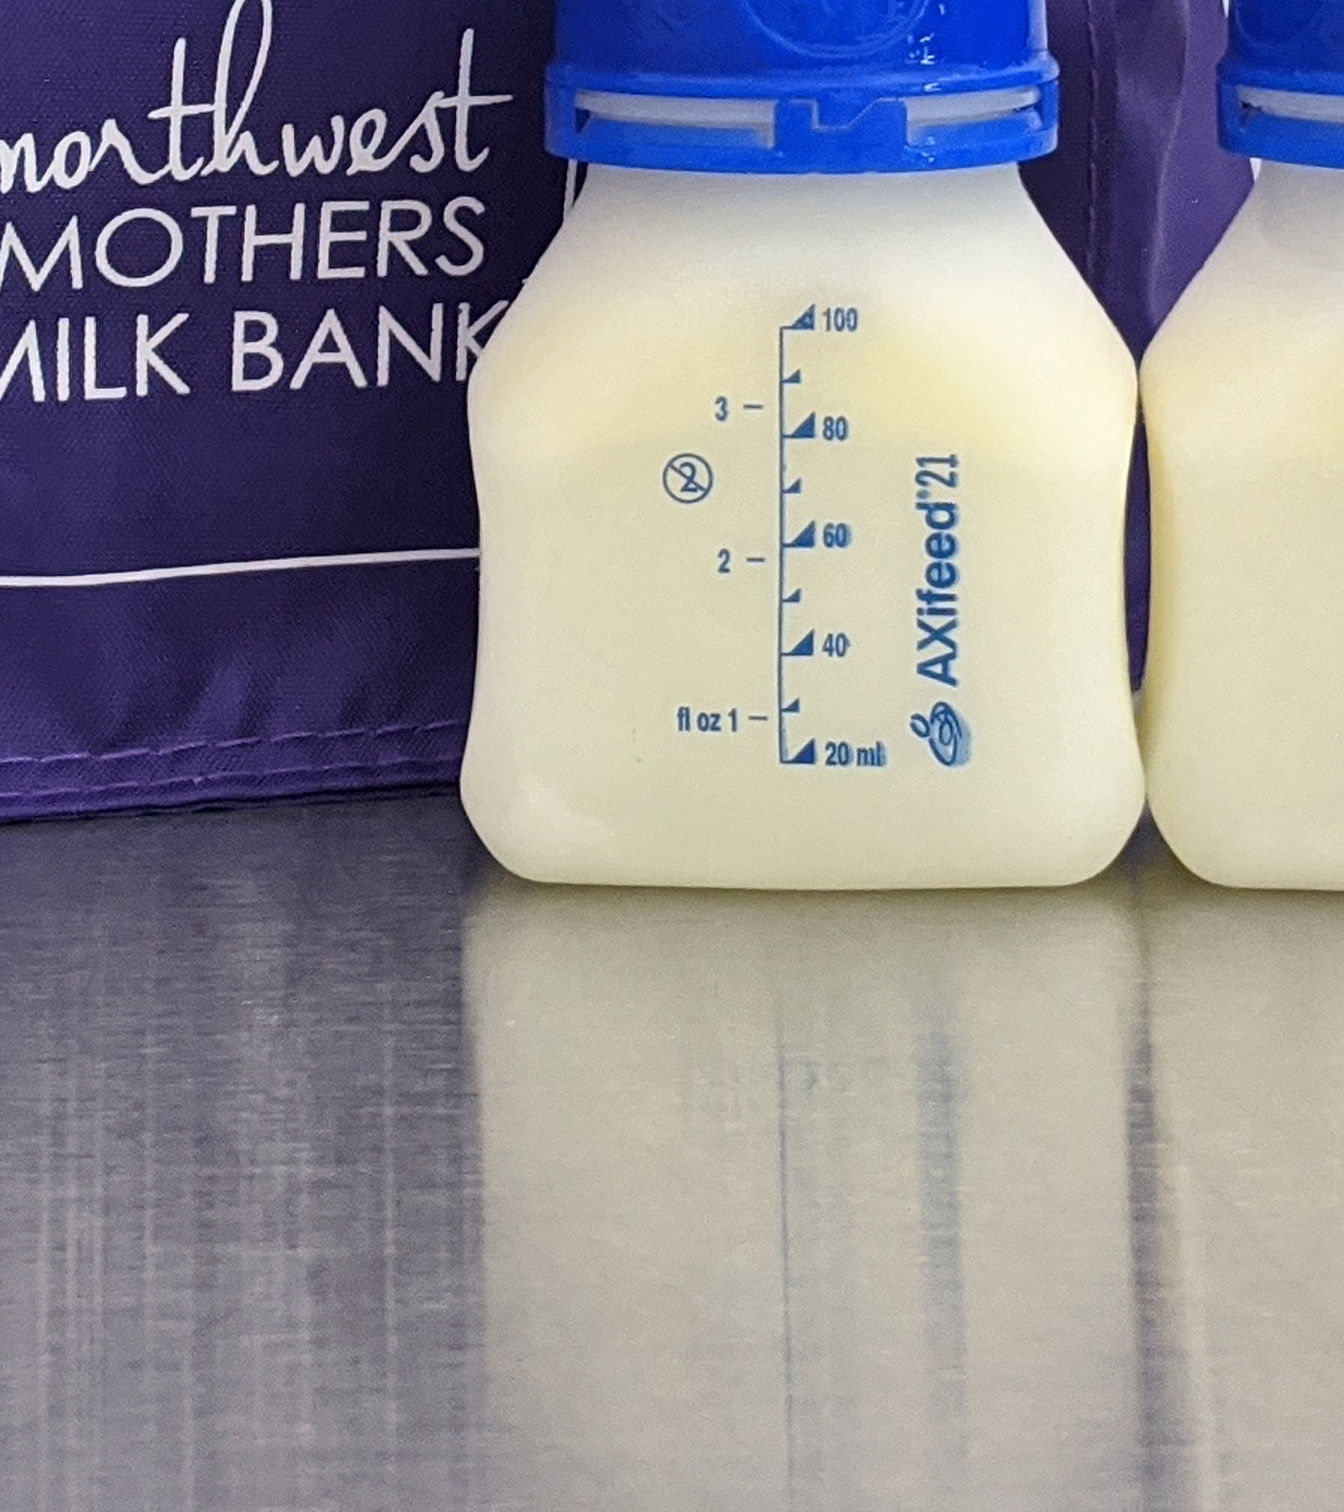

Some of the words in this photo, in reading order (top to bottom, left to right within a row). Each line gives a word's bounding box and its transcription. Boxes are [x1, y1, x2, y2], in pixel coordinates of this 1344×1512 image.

[821, 306, 859, 333] 100
[231, 300, 509, 392] BANK
[714, 395, 730, 423] 3
[821, 415, 850, 443] 80
[822, 522, 851, 549] 60
[717, 547, 732, 575] 2
[821, 631, 850, 659] 40
[696, 711, 723, 733] oz
[727, 707, 739, 733] 1
[824, 740, 851, 768] 20
[857, 740, 886, 768] ml
